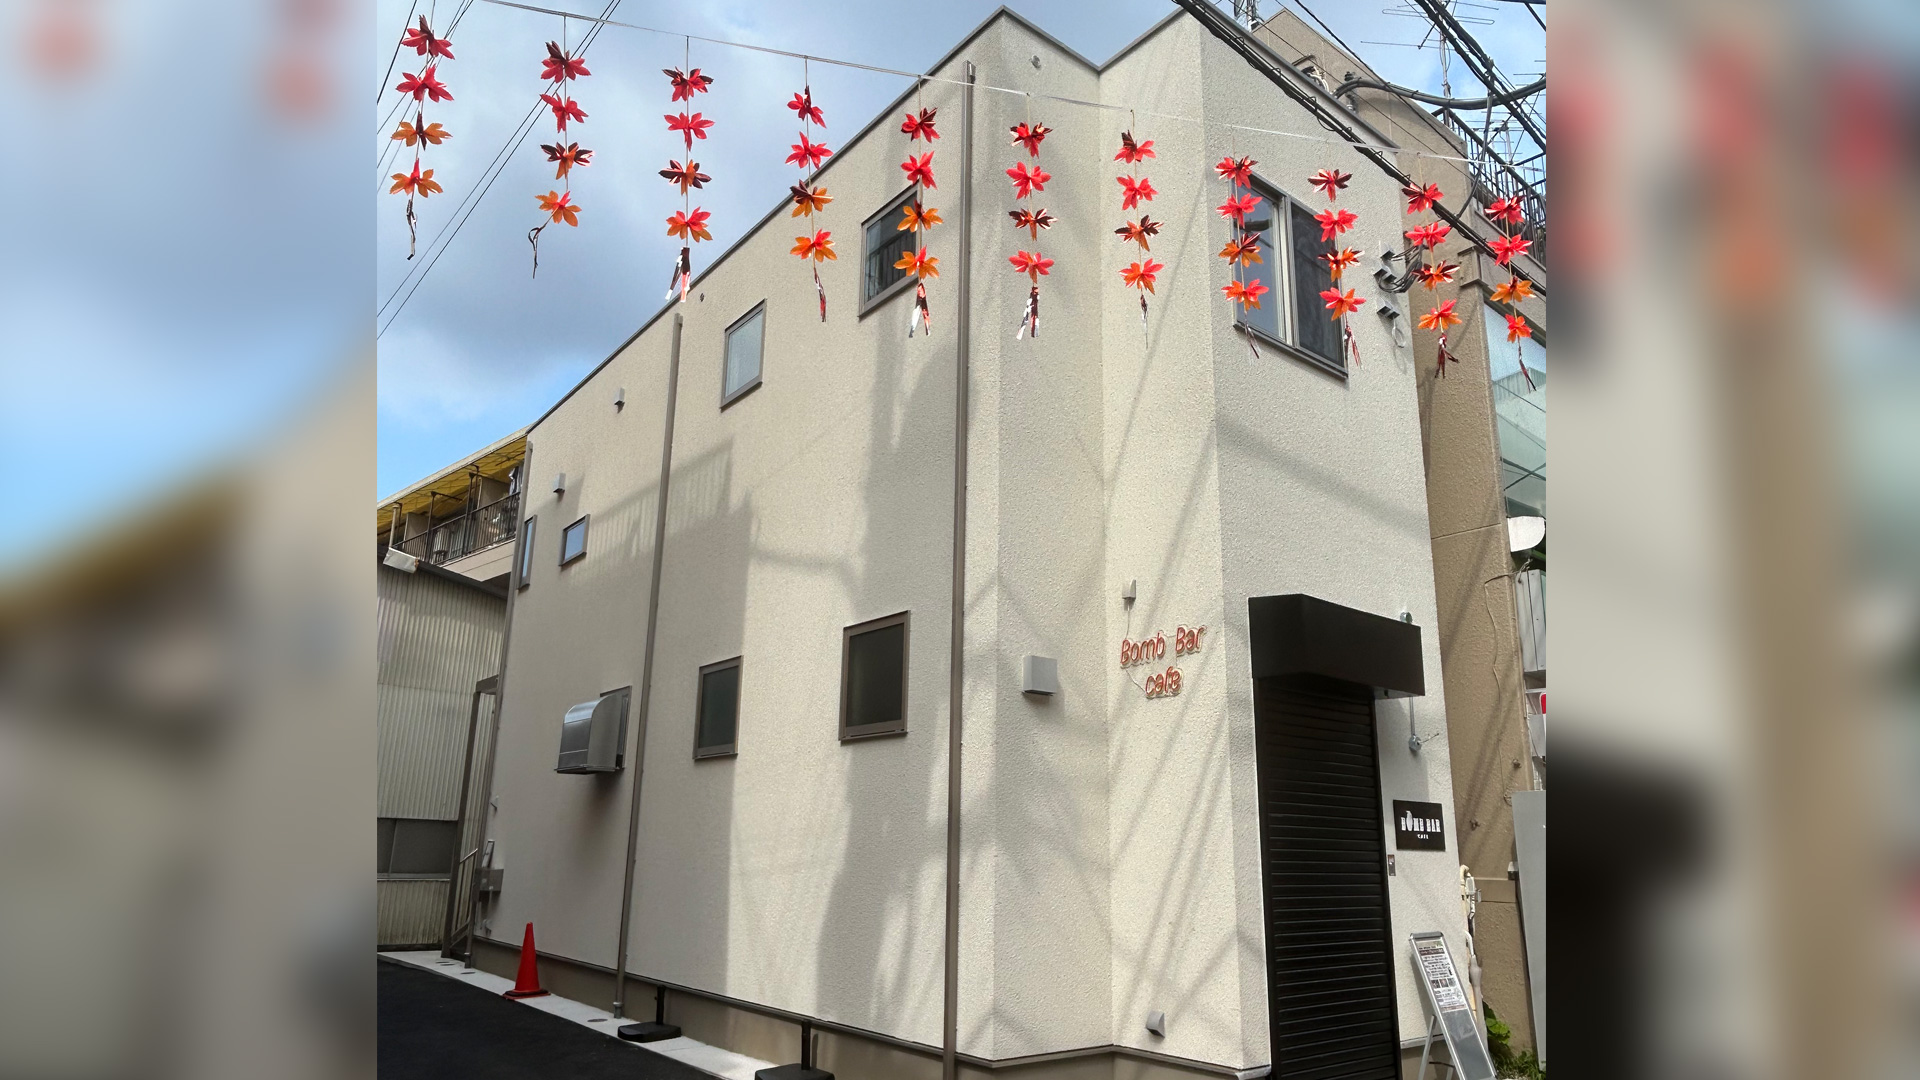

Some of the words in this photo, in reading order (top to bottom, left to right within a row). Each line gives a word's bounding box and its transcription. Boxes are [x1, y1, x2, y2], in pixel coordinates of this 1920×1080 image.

[1120, 631, 1166, 665] Bomb
[1175, 626, 1206, 655] Bar
[1426, 819, 1441, 832] BAR
